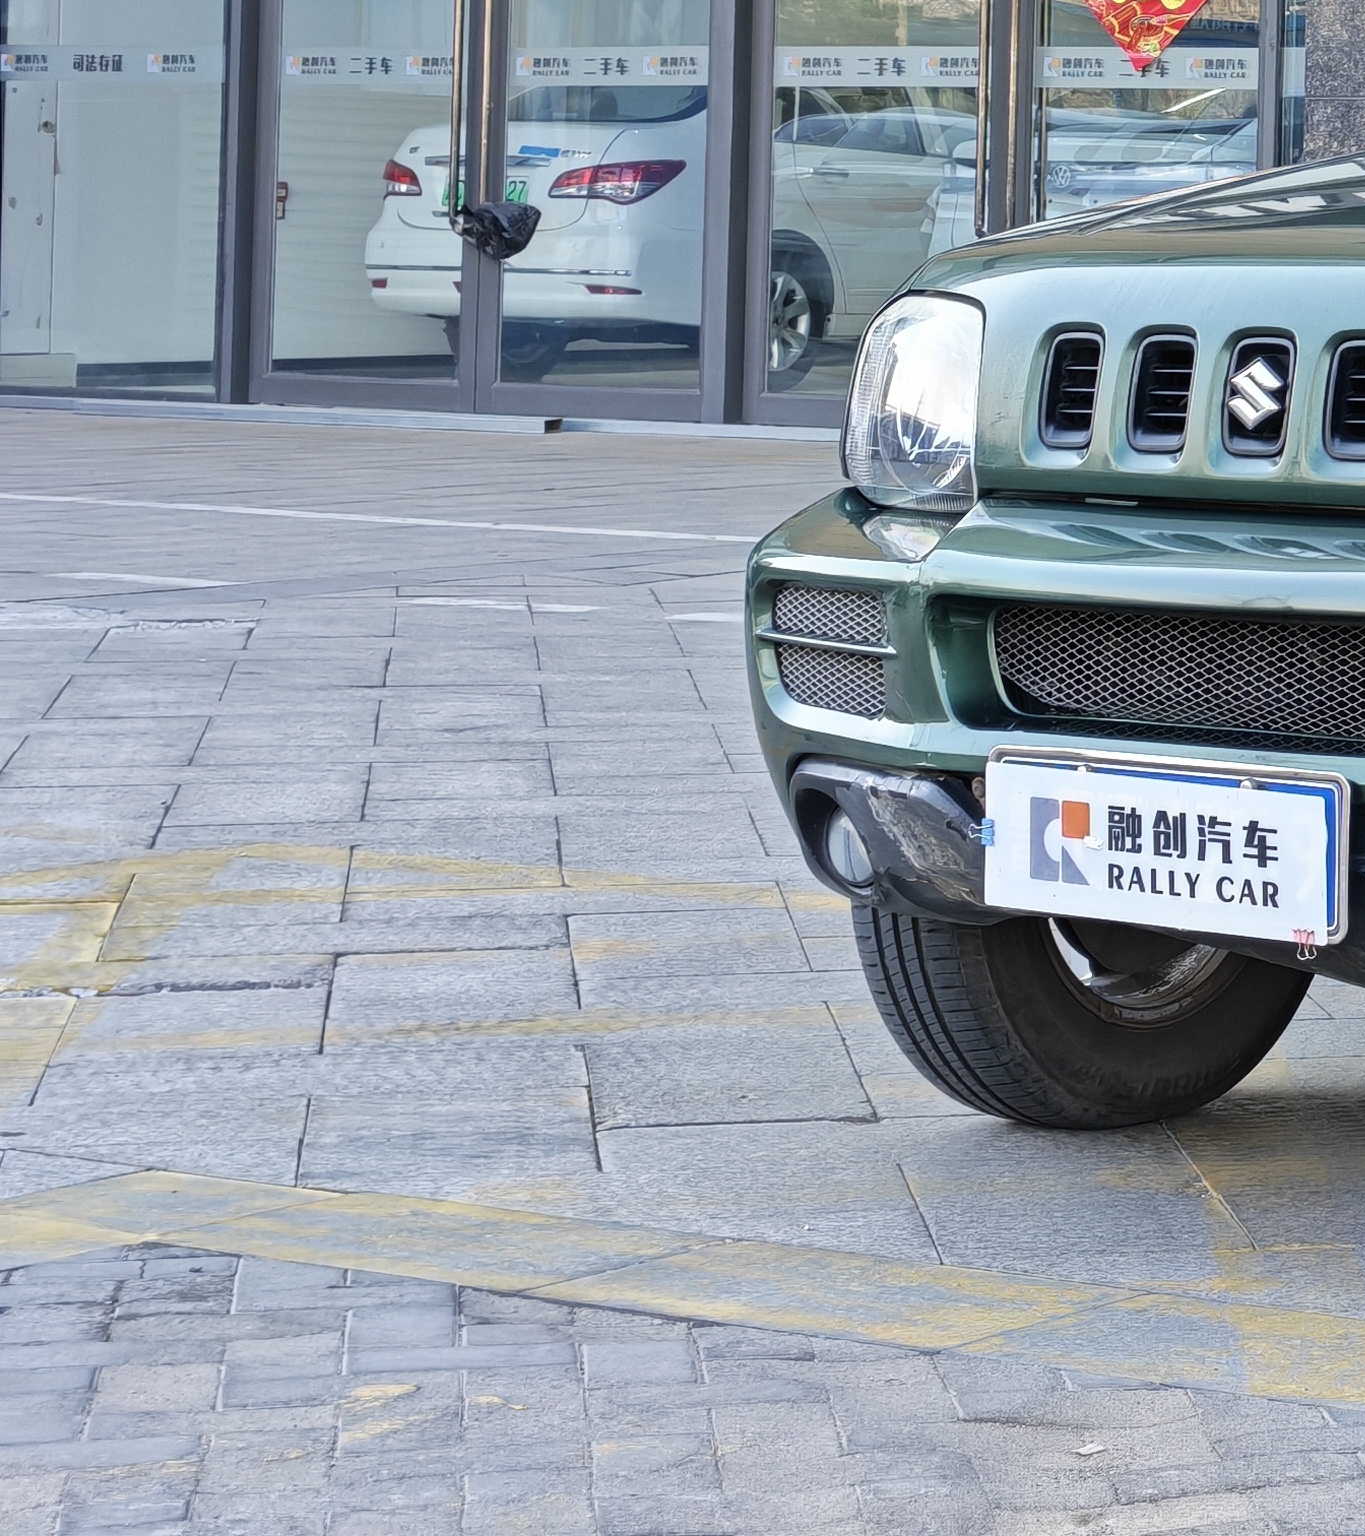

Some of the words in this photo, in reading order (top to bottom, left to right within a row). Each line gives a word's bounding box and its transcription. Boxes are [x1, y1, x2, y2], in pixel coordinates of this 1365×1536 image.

[72, 54, 124, 73] 司法存证
[349, 56, 394, 75] 二手车
[583, 57, 630, 76] 二手车
[856, 57, 906, 77] 二手车
[1107, 805, 1279, 869] 融创汽车
[1107, 863, 1201, 899] RALLY
[1215, 875, 1280, 909] CAR
